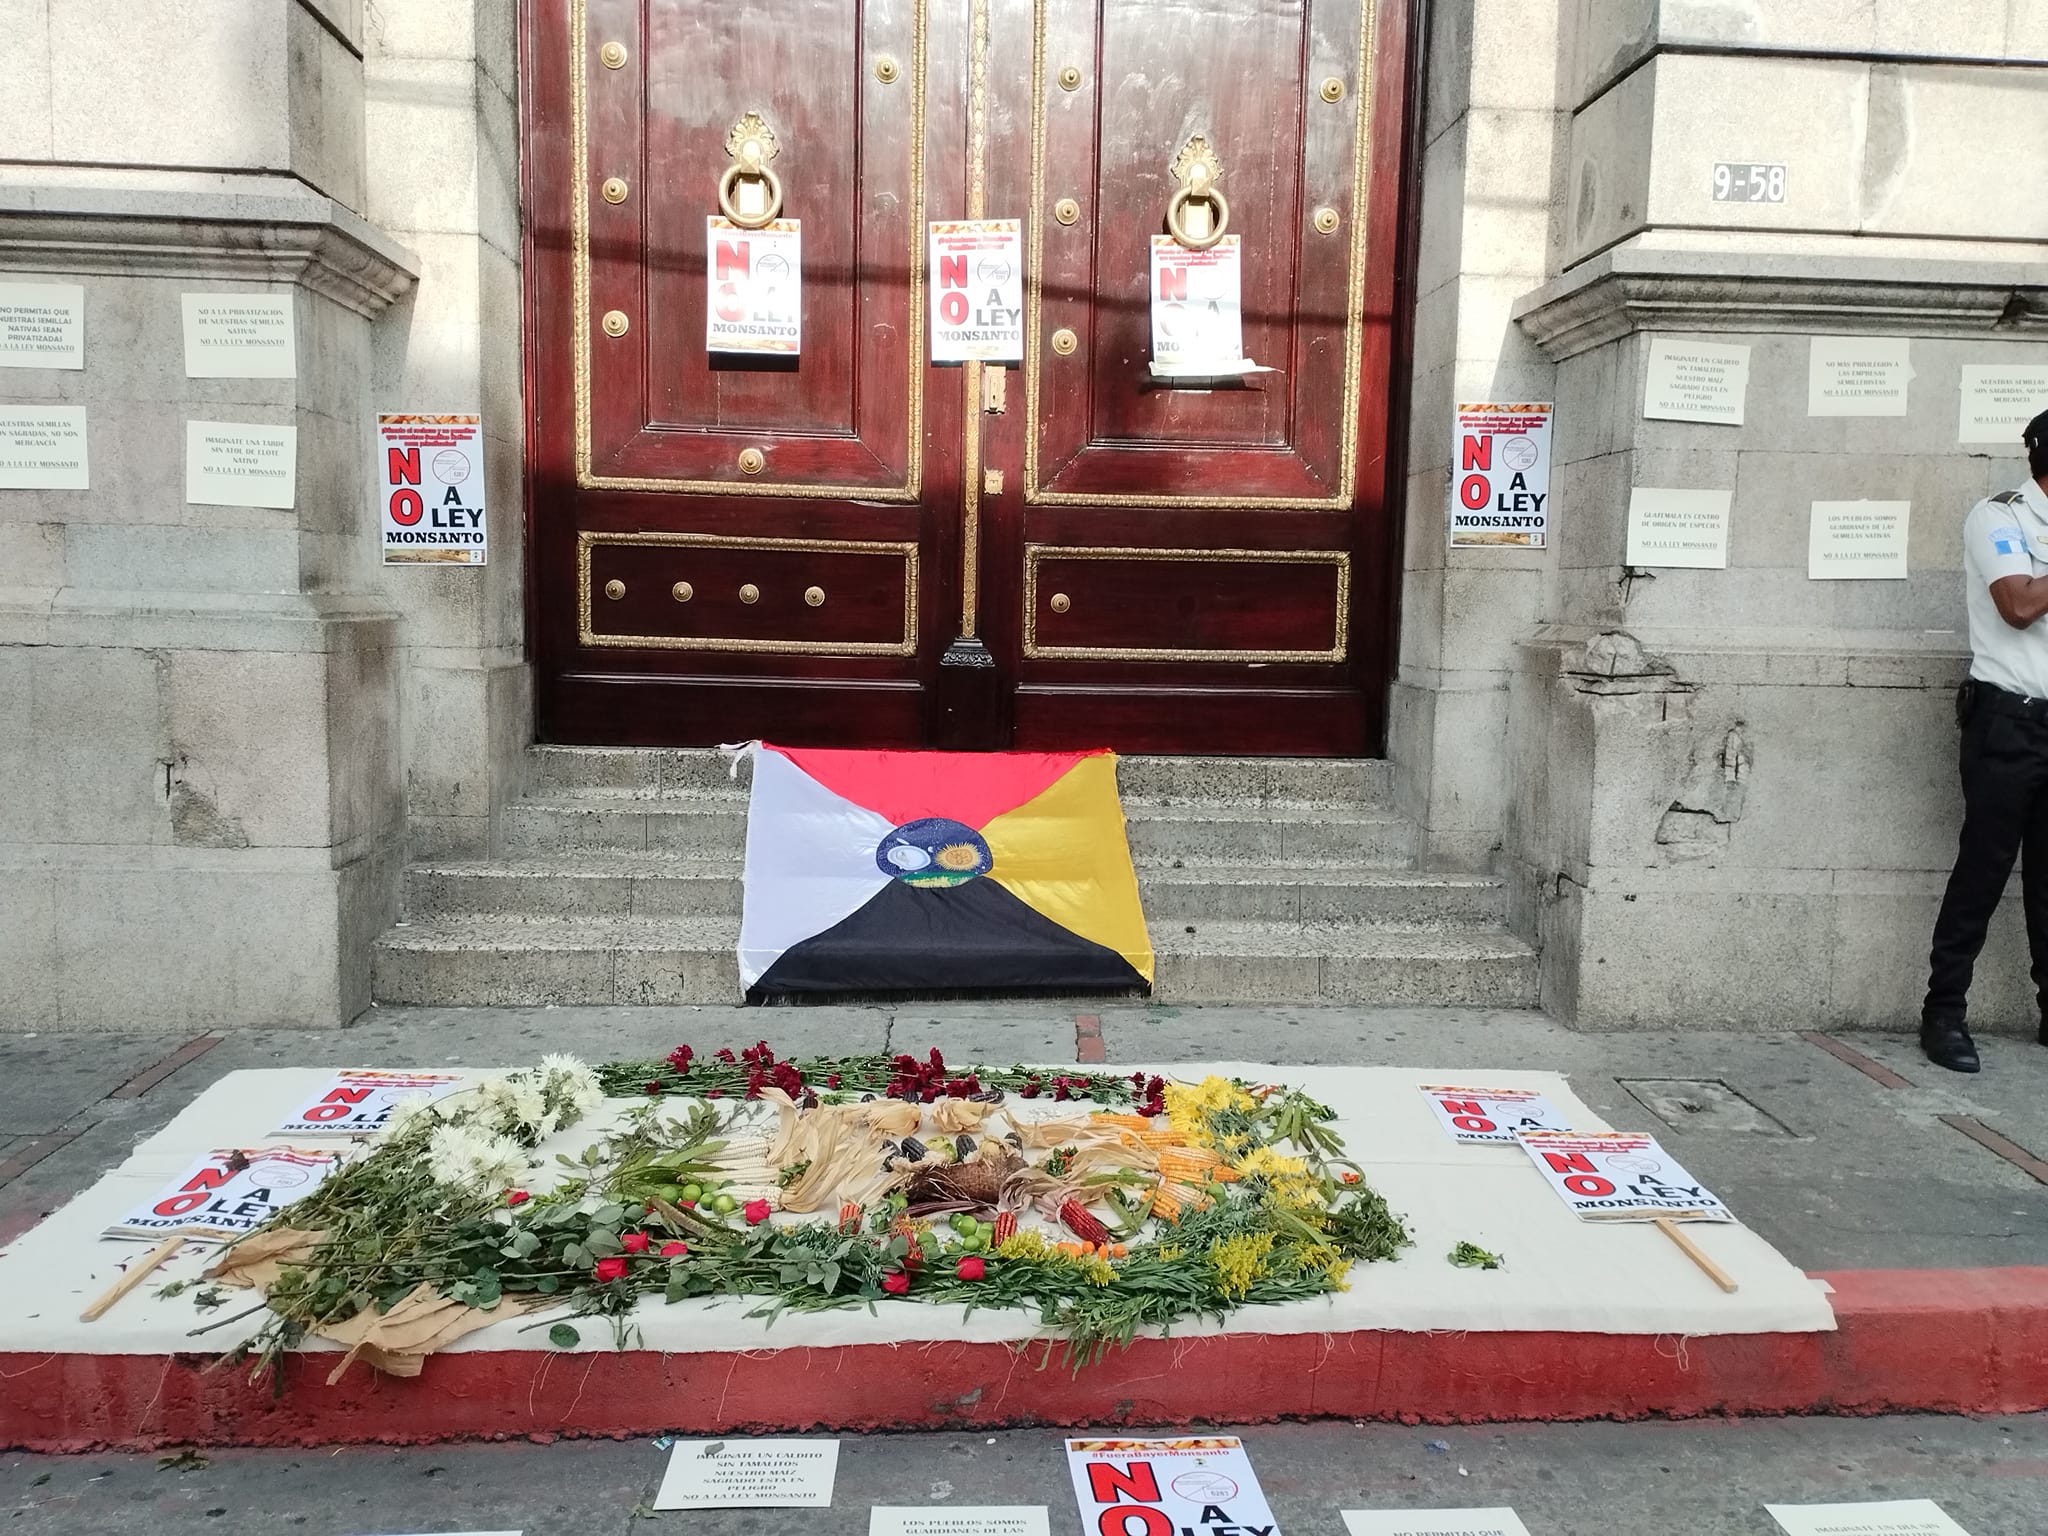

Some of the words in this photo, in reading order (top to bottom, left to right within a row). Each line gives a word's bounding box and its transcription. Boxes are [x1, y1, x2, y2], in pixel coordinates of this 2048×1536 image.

[1714, 164, 1785, 201] 9-58
[940, 255, 970, 326] NO
[986, 288, 1003, 306] A
[38, 317, 72, 325] SEMILLAS
[976, 309, 1021, 327] LEY
[8, 325, 41, 333] NATIVAS
[713, 323, 798, 337] MONSANTO
[938, 331, 1020, 341] MONSANTO
[8, 334, 63, 342] PRIVATIZADAS
[248, 468, 287, 477] MONSANTO
[1460, 435, 1493, 510] NO
[388, 448, 424, 526] NO
[1509, 472, 1527, 491] A
[443, 486, 463, 505] A
[1498, 493, 1547, 512] LEY
[432, 508, 484, 528] LEY
[1455, 516, 1545, 527] MONSANTO
[386, 532, 484, 544] MONSANTO
[302, 1088, 375, 1121] NO
[352, 1113, 395, 1123] LE
[1439, 1100, 1497, 1133] NO
[1520, 1118, 1544, 1127] A
[1541, 1152, 1617, 1197] NO
[1638, 1174, 1667, 1186] A
[153, 1168, 241, 1217] NO
[241, 1187, 273, 1203] A
[1627, 1184, 1702, 1198] LEY
[1573, 1199, 1718, 1209] MONSANTO
[123, 1214, 259, 1229] MONSANT
[1092, 1449, 1230, 1459] #FueraBayerMonsanto
[1200, 1505, 1235, 1524] A
